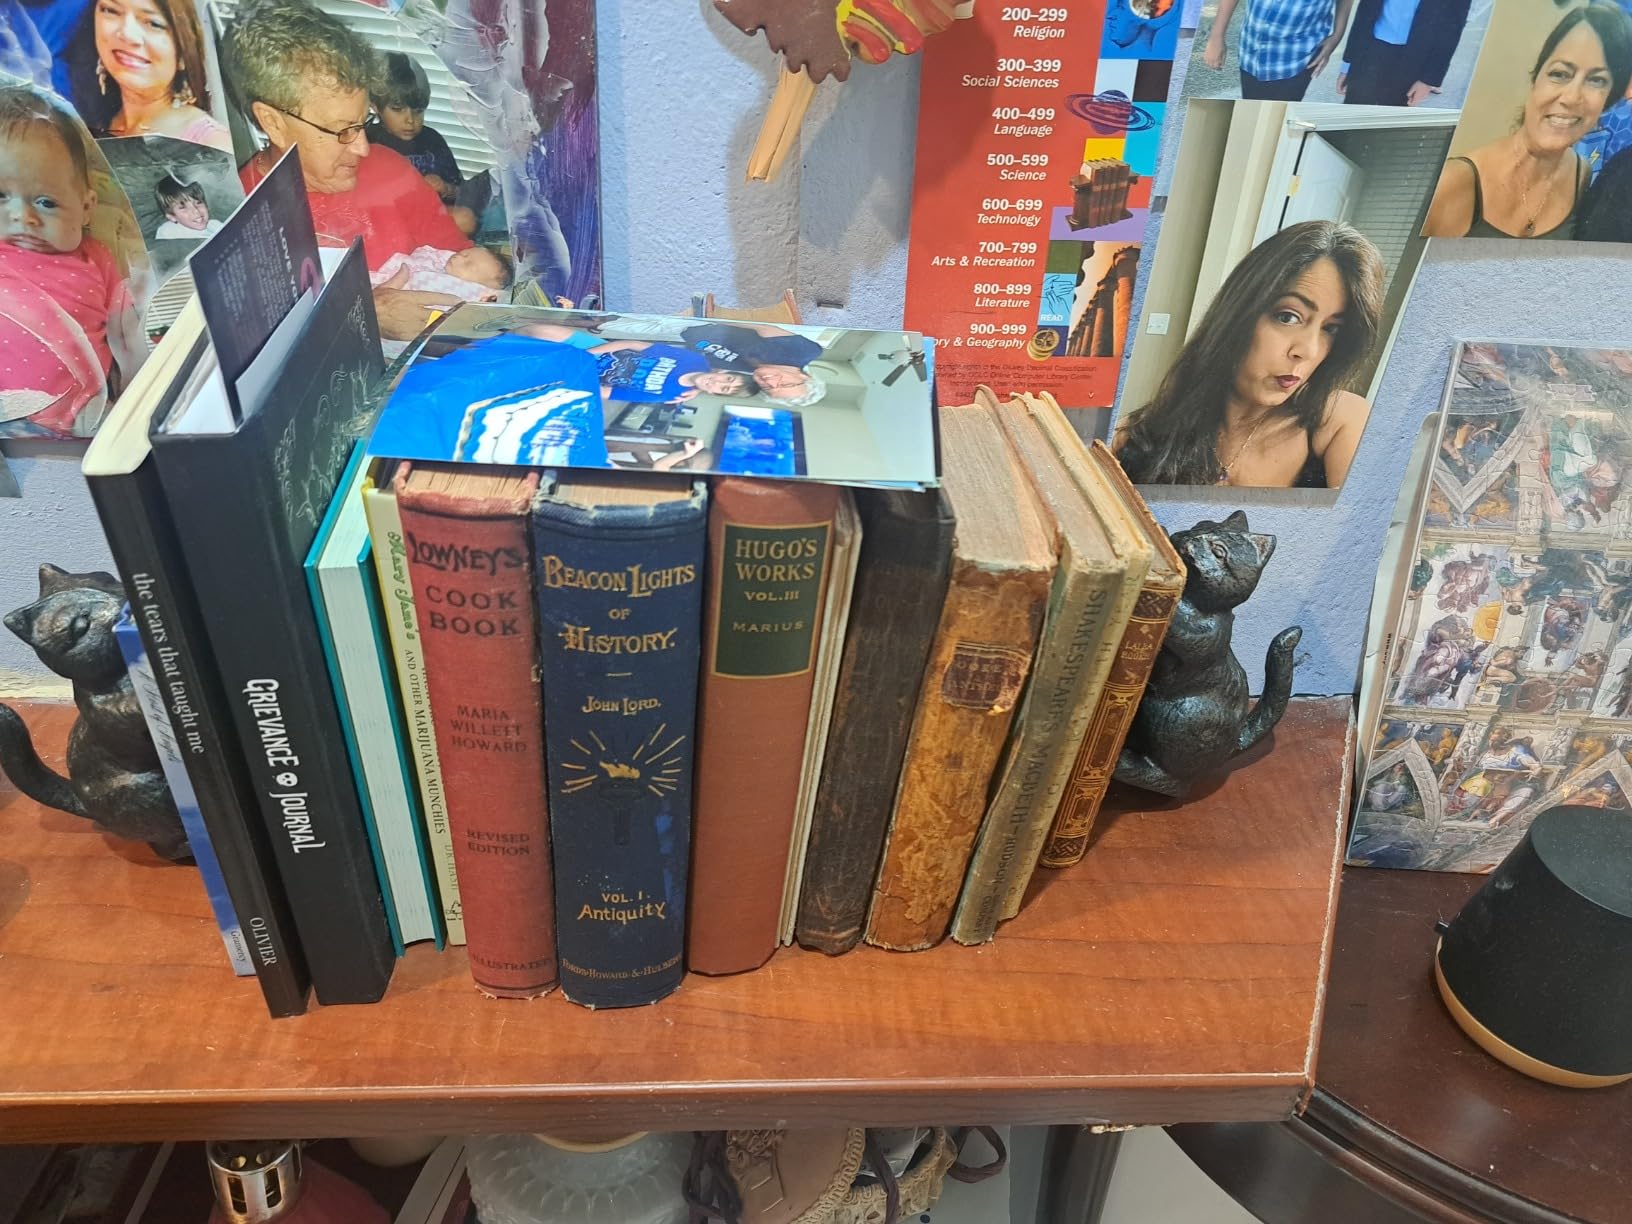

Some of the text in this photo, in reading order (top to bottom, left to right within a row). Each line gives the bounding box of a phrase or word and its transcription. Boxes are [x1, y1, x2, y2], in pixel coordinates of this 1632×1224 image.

[1001, 7, 1067, 22] 200–299
[1013, 25, 1065, 39] Religion
[997, 58, 1061, 72] 300–399
[962, 74, 1059, 89] Social Sciences
[992, 107, 1055, 121] 400–499
[993, 123, 1053, 137] Language
[987, 153, 1048, 167] 500–599
[999, 169, 1046, 181] Science
[982, 198, 1042, 211] 600–699
[976, 213, 1041, 226] Technology
[978, 241, 1037, 254] 700–799
[278, 226, 299, 303] LOVE YO
[931, 256, 1035, 268] Arts & Recreation
[973, 283, 1032, 295] 800–899
[975, 297, 1030, 308] Literature
[970, 323, 1027, 335] 900–999
[953, 337, 964, 348] &
[966, 337, 1025, 350] Geography
[406, 531, 524, 576] LOWNEY'S
[735, 538, 818, 560] HUGO'S
[542, 555, 696, 597] BEACON LIGHTS
[735, 562, 816, 582] WORKS
[425, 585, 519, 611] COOK
[608, 608, 632, 620] OF
[429, 610, 521, 637] BOOK
[732, 620, 804, 633] MARIUS
[558, 622, 678, 654] HISTORY.
[132, 572, 204, 754] the tears that taught me
[404, 648, 417, 670] AND
[408, 672, 423, 707] OTHER
[457, 704, 511, 721] MARIA
[581, 695, 662, 716] JOHN LORD.
[450, 719, 522, 738] WILLETT
[414, 708, 435, 775] MARIJUANA
[451, 736, 527, 753] HOWARD
[242, 678, 326, 853] GRIEVANCE JOURNAL
[427, 778, 446, 835] MUNCHIES
[467, 828, 530, 843] REVISED
[467, 841, 530, 856] EDITION
[601, 893, 634, 904] VOL.
[577, 902, 667, 926] Antiquity
[249, 916, 277, 966] OLIVIER
